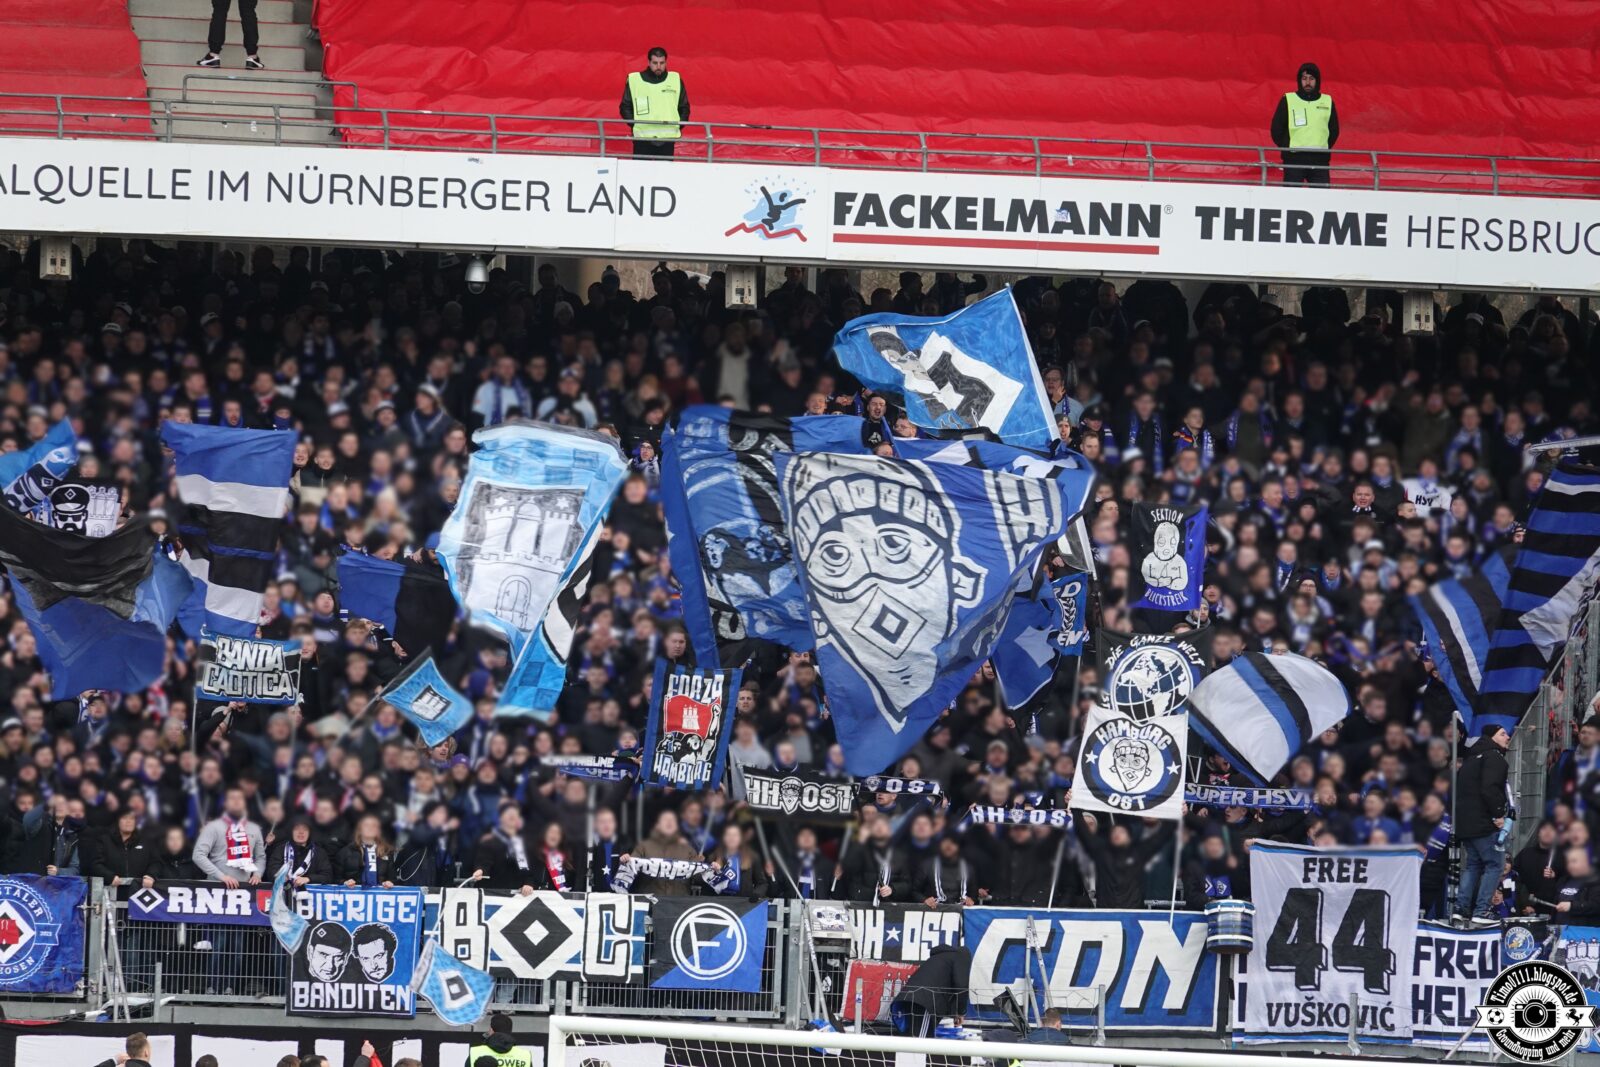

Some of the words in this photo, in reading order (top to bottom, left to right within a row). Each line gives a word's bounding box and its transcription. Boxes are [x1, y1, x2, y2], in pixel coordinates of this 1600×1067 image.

[208, 169, 249, 202] IM
[267, 165, 551, 212] NÜRNBERGER
[567, 181, 677, 217] LAND
[1195, 205, 1388, 247] THERME
[1150, 508, 1184, 524] SEKTION
[1105, 644, 1124, 670] DIE
[1129, 634, 1175, 648] GANZE
[1177, 640, 1206, 668] WELT
[668, 673, 725, 705] FORZA
[1095, 718, 1173, 751] HAMBURG
[653, 752, 712, 785] HAMBURG
[744, 777, 782, 809] HH
[801, 782, 854, 813] OST
[1107, 793, 1147, 811] OST
[1186, 783, 1247, 805] SUPER
[971, 805, 1005, 824] HH
[1302, 857, 1369, 884] FREE
[167, 886, 252, 916] RNR
[296, 890, 417, 923] BIERIGE
[901, 910, 959, 961] OST
[1265, 887, 1397, 995] 44
[968, 918, 1208, 1010] CDN
[292, 980, 410, 1011] BANDITEN
